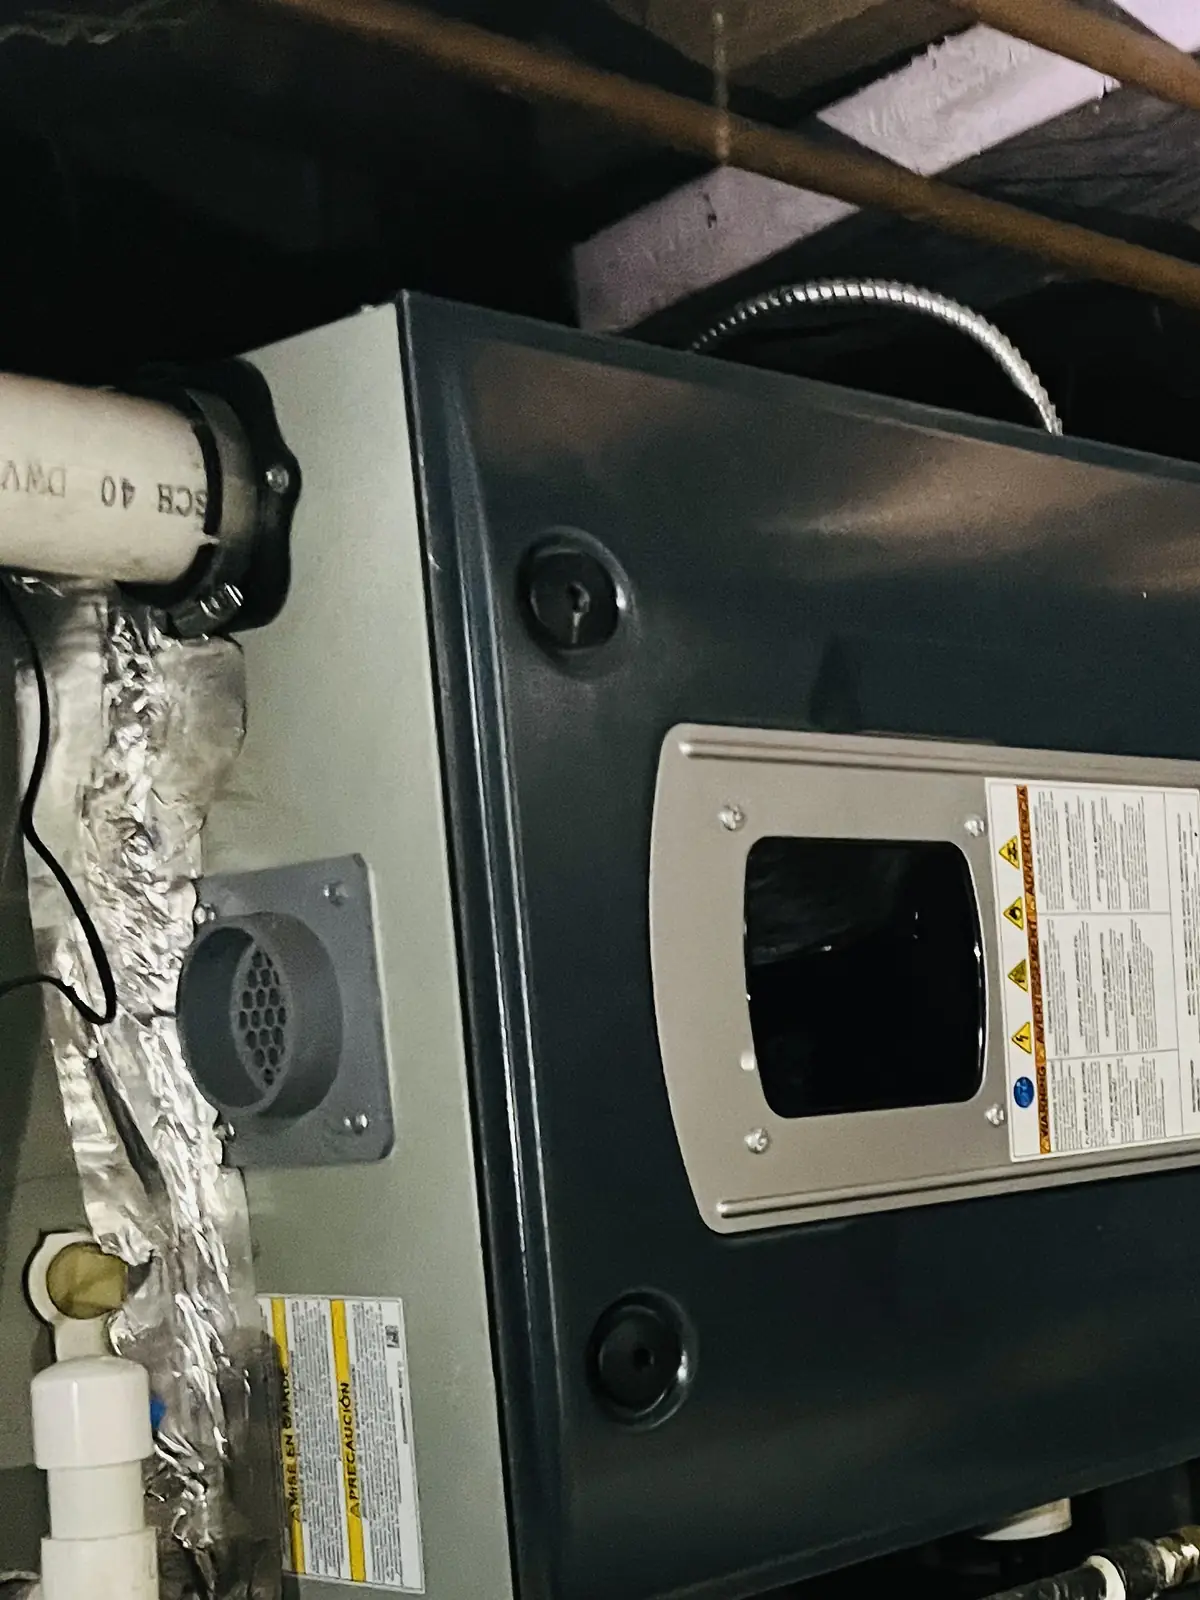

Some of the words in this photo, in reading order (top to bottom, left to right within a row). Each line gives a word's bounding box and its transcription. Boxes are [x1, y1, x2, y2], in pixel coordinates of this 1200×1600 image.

[1, 459, 66, 497] DWV
[101, 474, 136, 511] 40
[157, 483, 208, 518] SCH
[1037, 1066, 1049, 1136] WARNING
[285, 1434, 296, 1457] EN
[339, 1382, 357, 1501] PRECAUCIÓN
[287, 1464, 298, 1499] MISE
